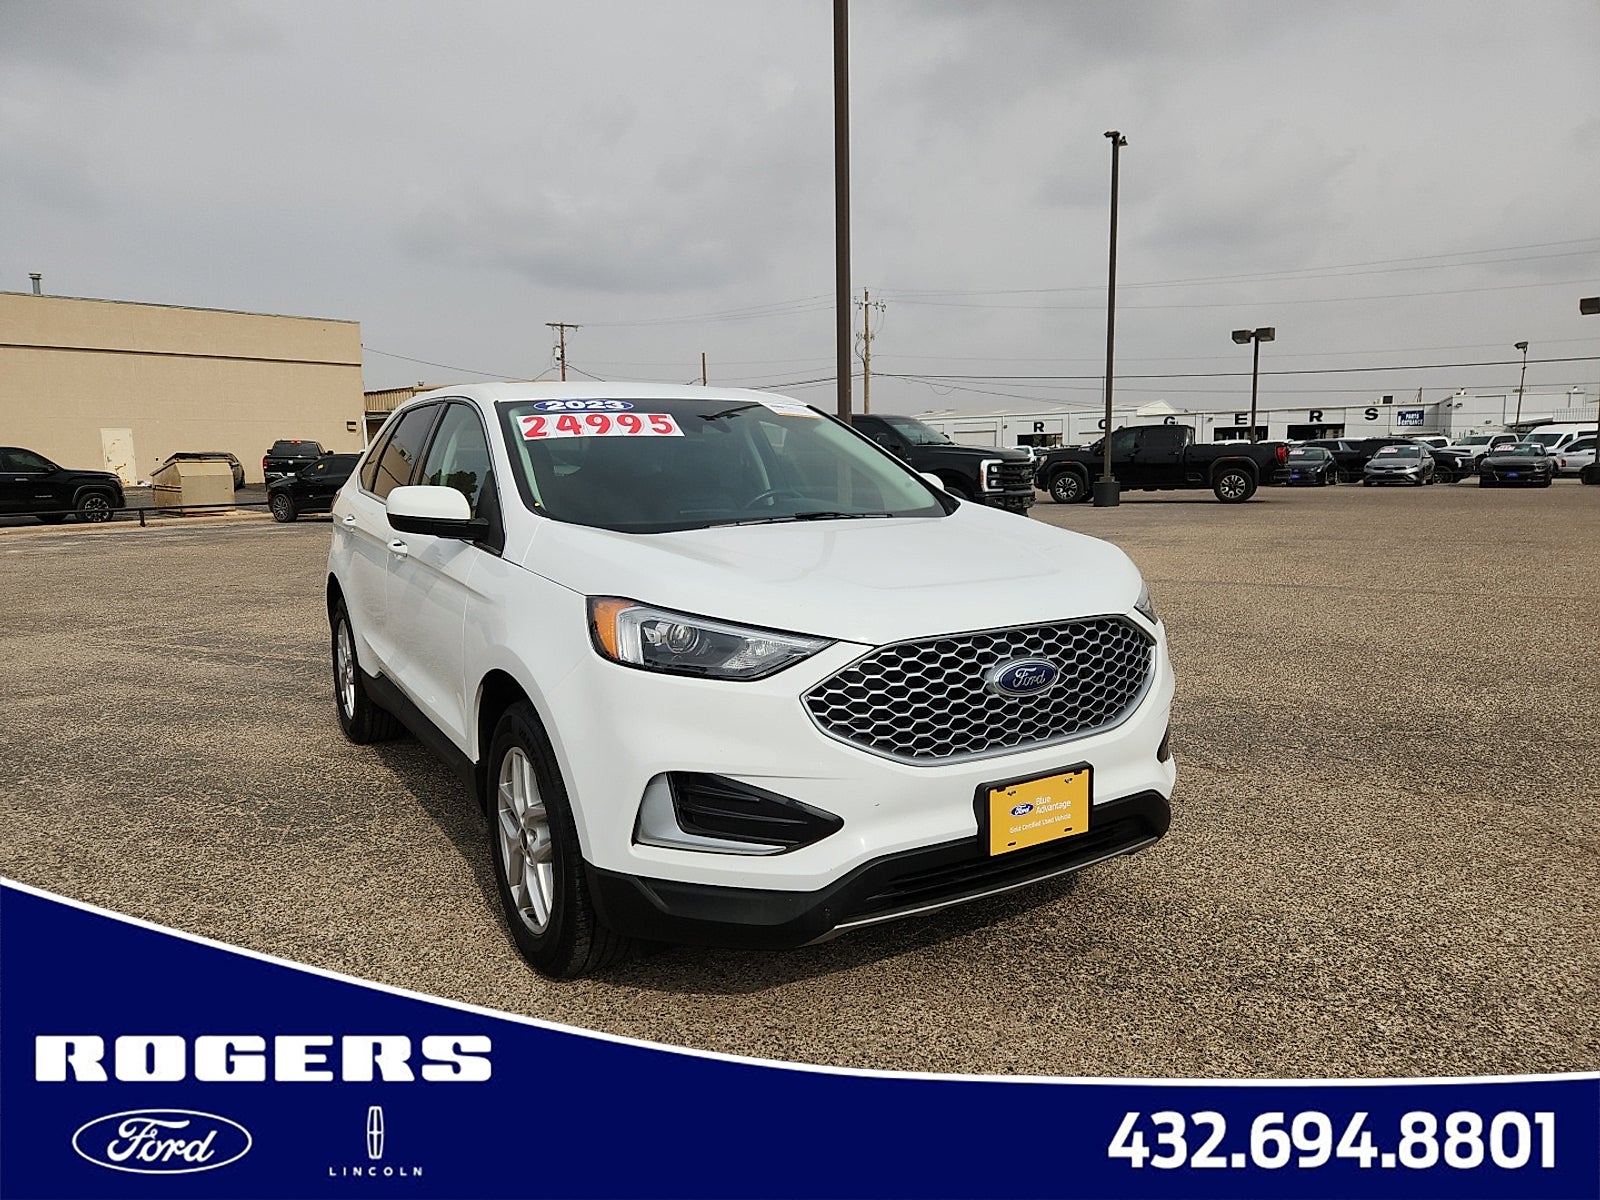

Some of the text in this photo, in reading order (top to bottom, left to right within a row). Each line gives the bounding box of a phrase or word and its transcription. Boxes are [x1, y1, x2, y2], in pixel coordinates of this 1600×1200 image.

[546, 400, 623, 411] 2023
[522, 413, 676, 438] 24995
[1012, 667, 1046, 688] Ford
[1035, 796, 1052, 806] Blue
[1035, 800, 1072, 815] Advantage
[1014, 803, 1031, 816] Ford
[1055, 813, 1072, 823] Vehicle
